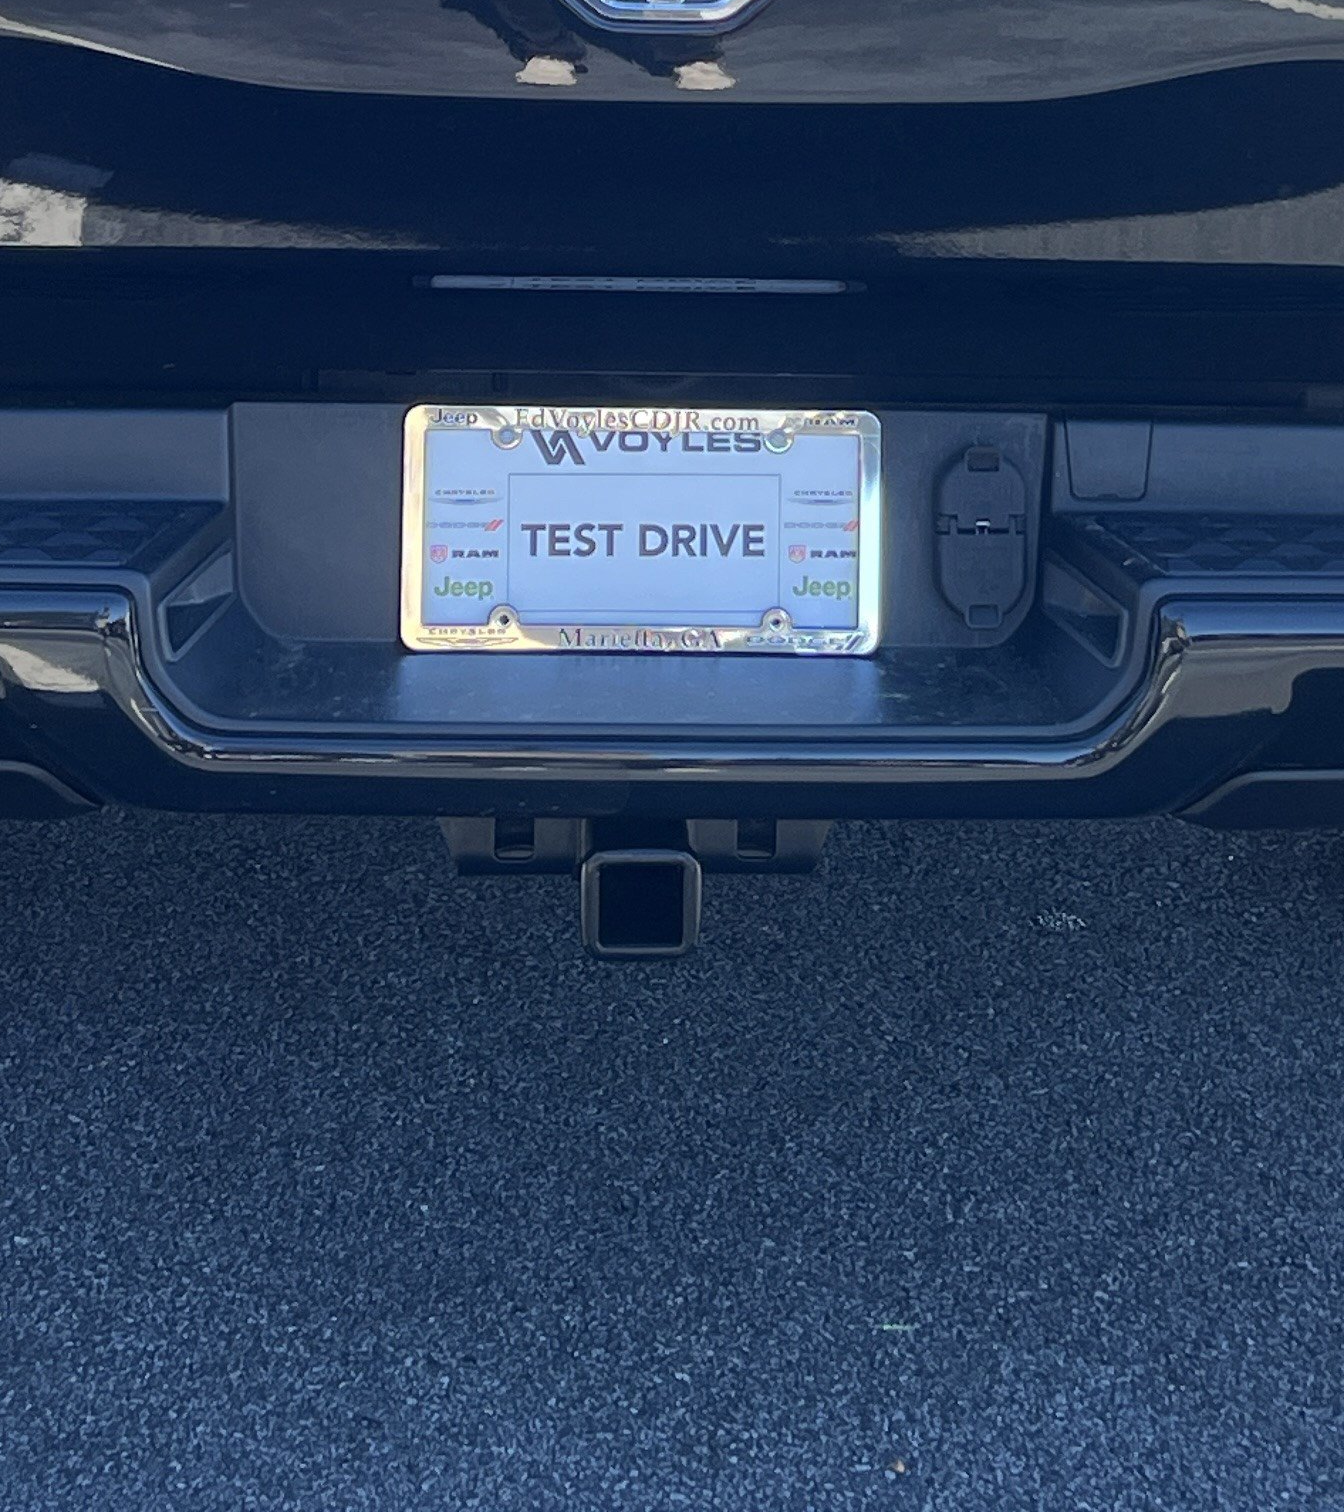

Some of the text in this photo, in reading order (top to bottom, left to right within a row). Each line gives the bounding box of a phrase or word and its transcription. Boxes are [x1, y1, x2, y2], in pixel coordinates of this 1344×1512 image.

[431, 408, 479, 426] Jeep
[515, 407, 760, 438] EdVoylesCDJR.com
[590, 431, 762, 453] VOYLES
[521, 523, 766, 558] TEST DRIVE
[451, 549, 500, 559] RAM
[810, 549, 856, 559] RAM
[434, 576, 495, 600] Jeep
[792, 575, 852, 600] Jeep
